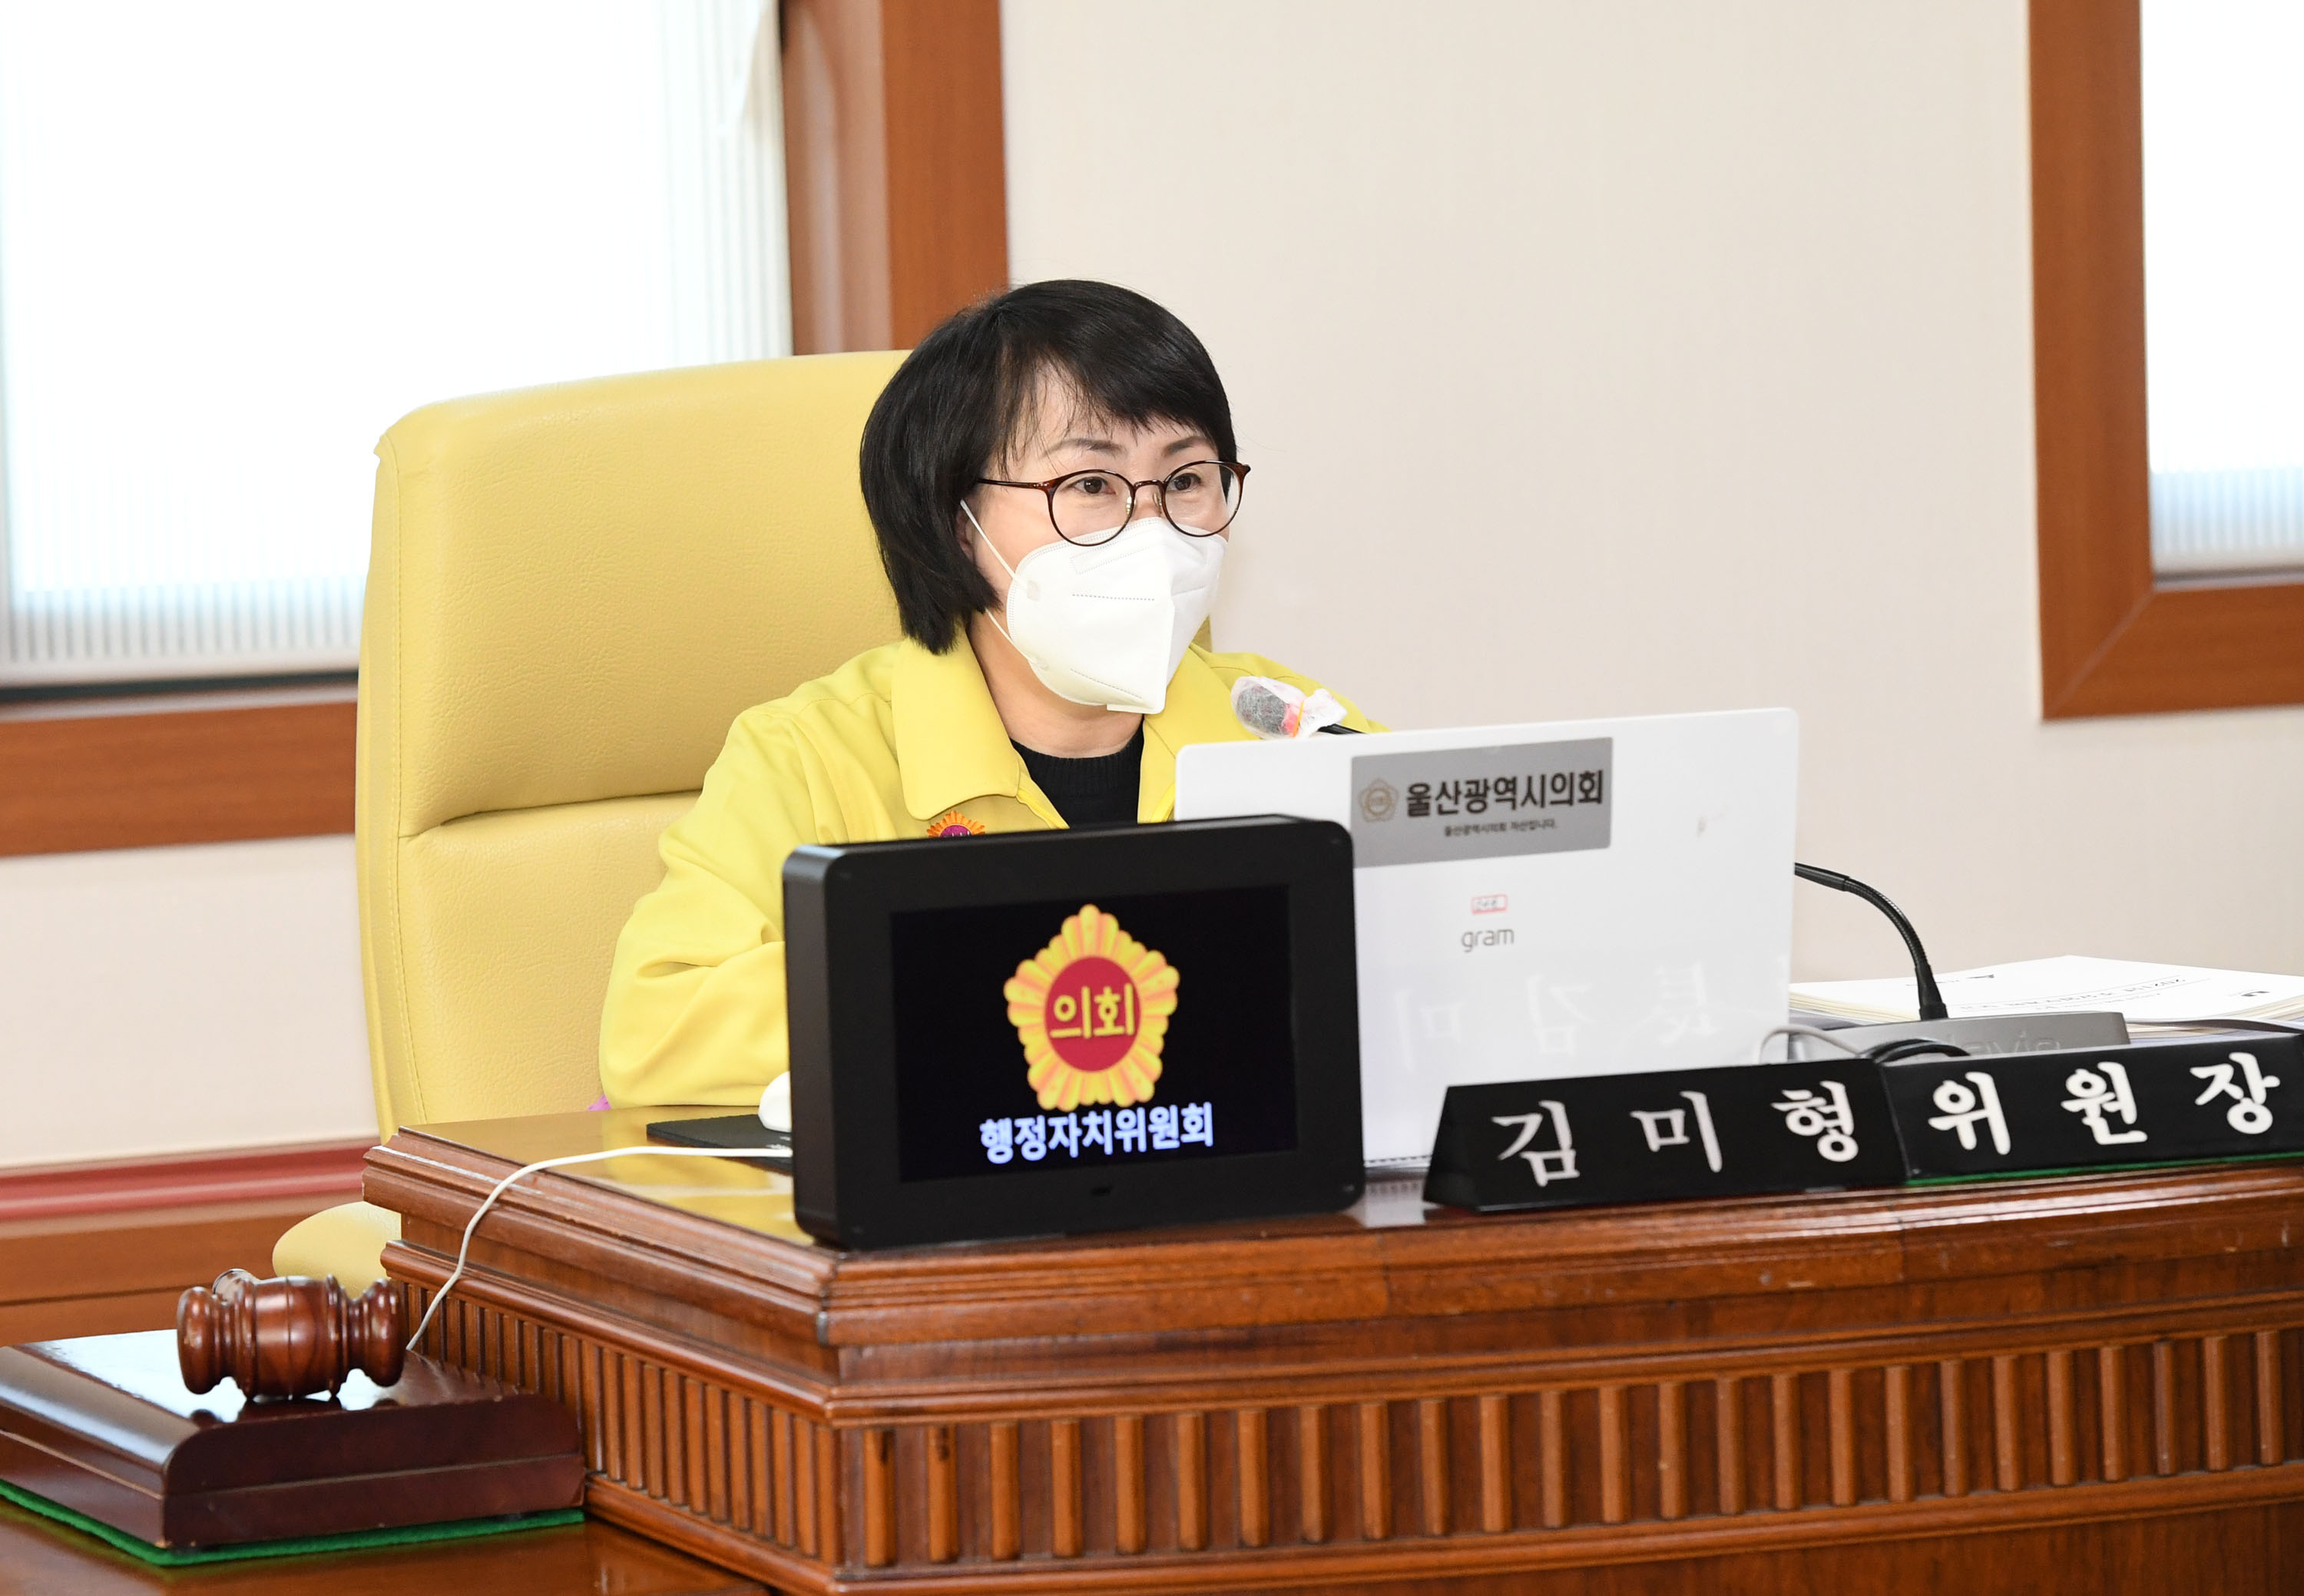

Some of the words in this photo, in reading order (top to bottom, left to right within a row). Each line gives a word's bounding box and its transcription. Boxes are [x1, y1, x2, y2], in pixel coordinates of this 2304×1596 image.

[1405, 770, 1604, 818] 울산광역시의회
[1461, 928, 1515, 953] gram
[1049, 982, 1135, 1040] 의회
[978, 1101, 1214, 1164] 행정자치위원회
